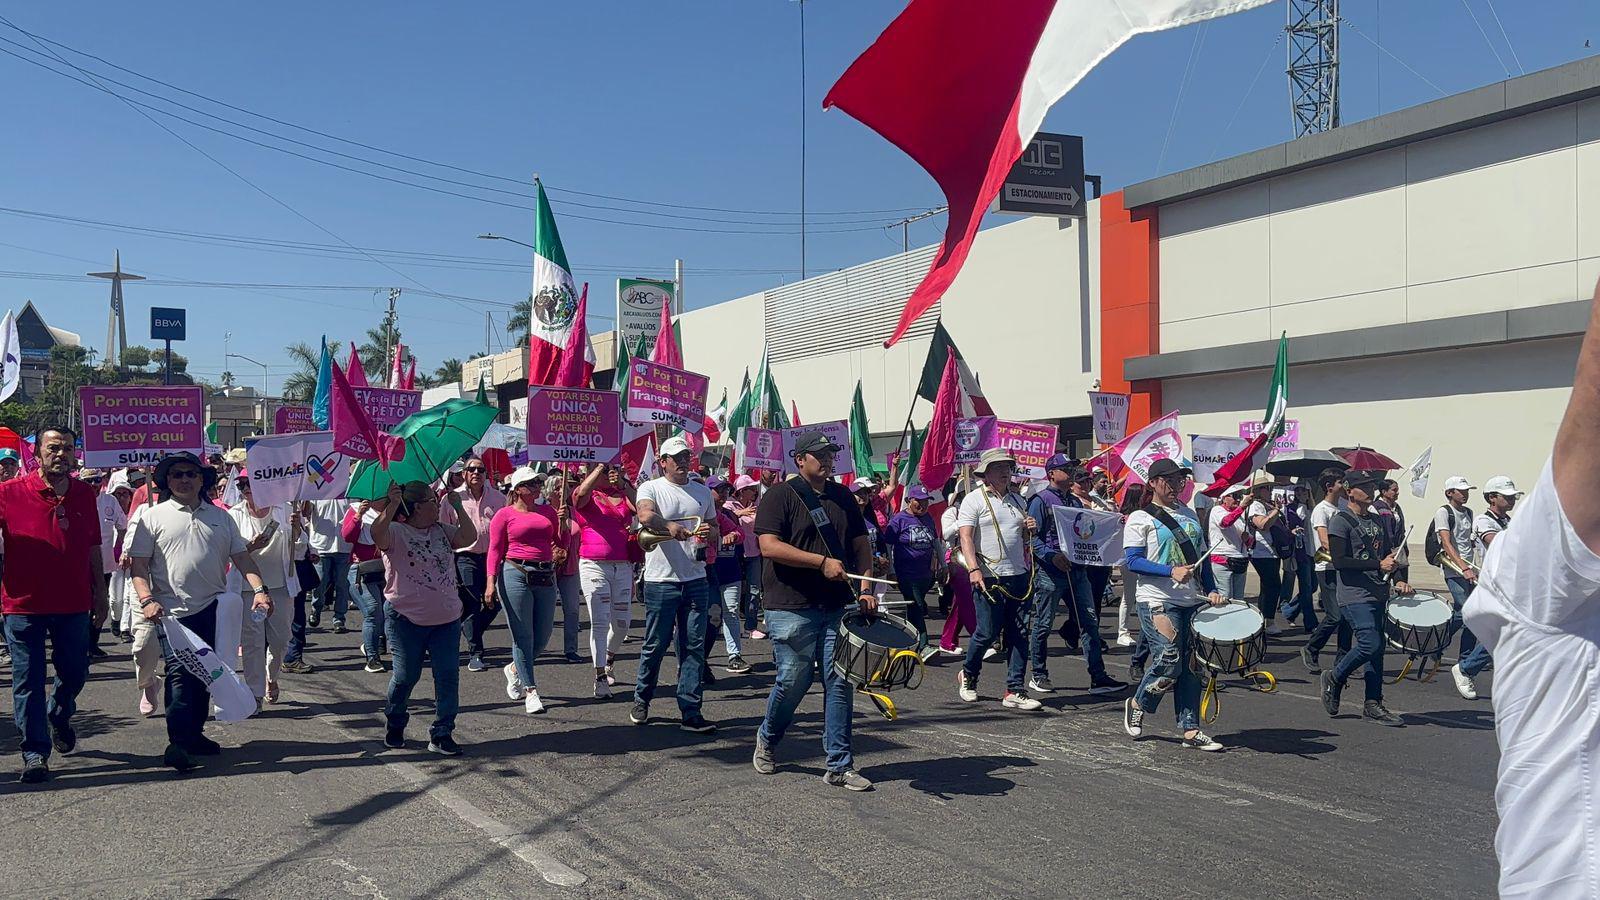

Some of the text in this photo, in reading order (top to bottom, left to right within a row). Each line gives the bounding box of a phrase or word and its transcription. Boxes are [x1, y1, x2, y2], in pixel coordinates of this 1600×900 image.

[1011, 188, 1072, 201] ESTACIONAMIENTO
[634, 292, 654, 304] ABC
[154, 319, 182, 327] BBVA
[653, 368, 687, 385] Por Tu
[634, 376, 679, 396] Derecho
[692, 391, 703, 403] La
[95, 394, 188, 407] Por nuestra
[391, 393, 416, 407] LEY
[546, 391, 603, 402] VOTAR ES LA
[631, 389, 702, 416] Transparencia
[363, 404, 405, 417] SPETO
[551, 400, 598, 414] UNICA
[88, 413, 198, 426] DEMOCRACIA
[547, 413, 601, 423] MANERA DE
[551, 424, 583, 432] HACER
[1285, 422, 1295, 431] EY
[103, 429, 184, 445] Estoy aquí
[545, 432, 603, 446] CAMBIO
[790, 430, 802, 438] Por
[1026, 431, 1049, 439] voto
[1000, 438, 1050, 454] LIBRE!!
[1073, 542, 1098, 551] PODER
[1073, 554, 1102, 562] SINALOA
